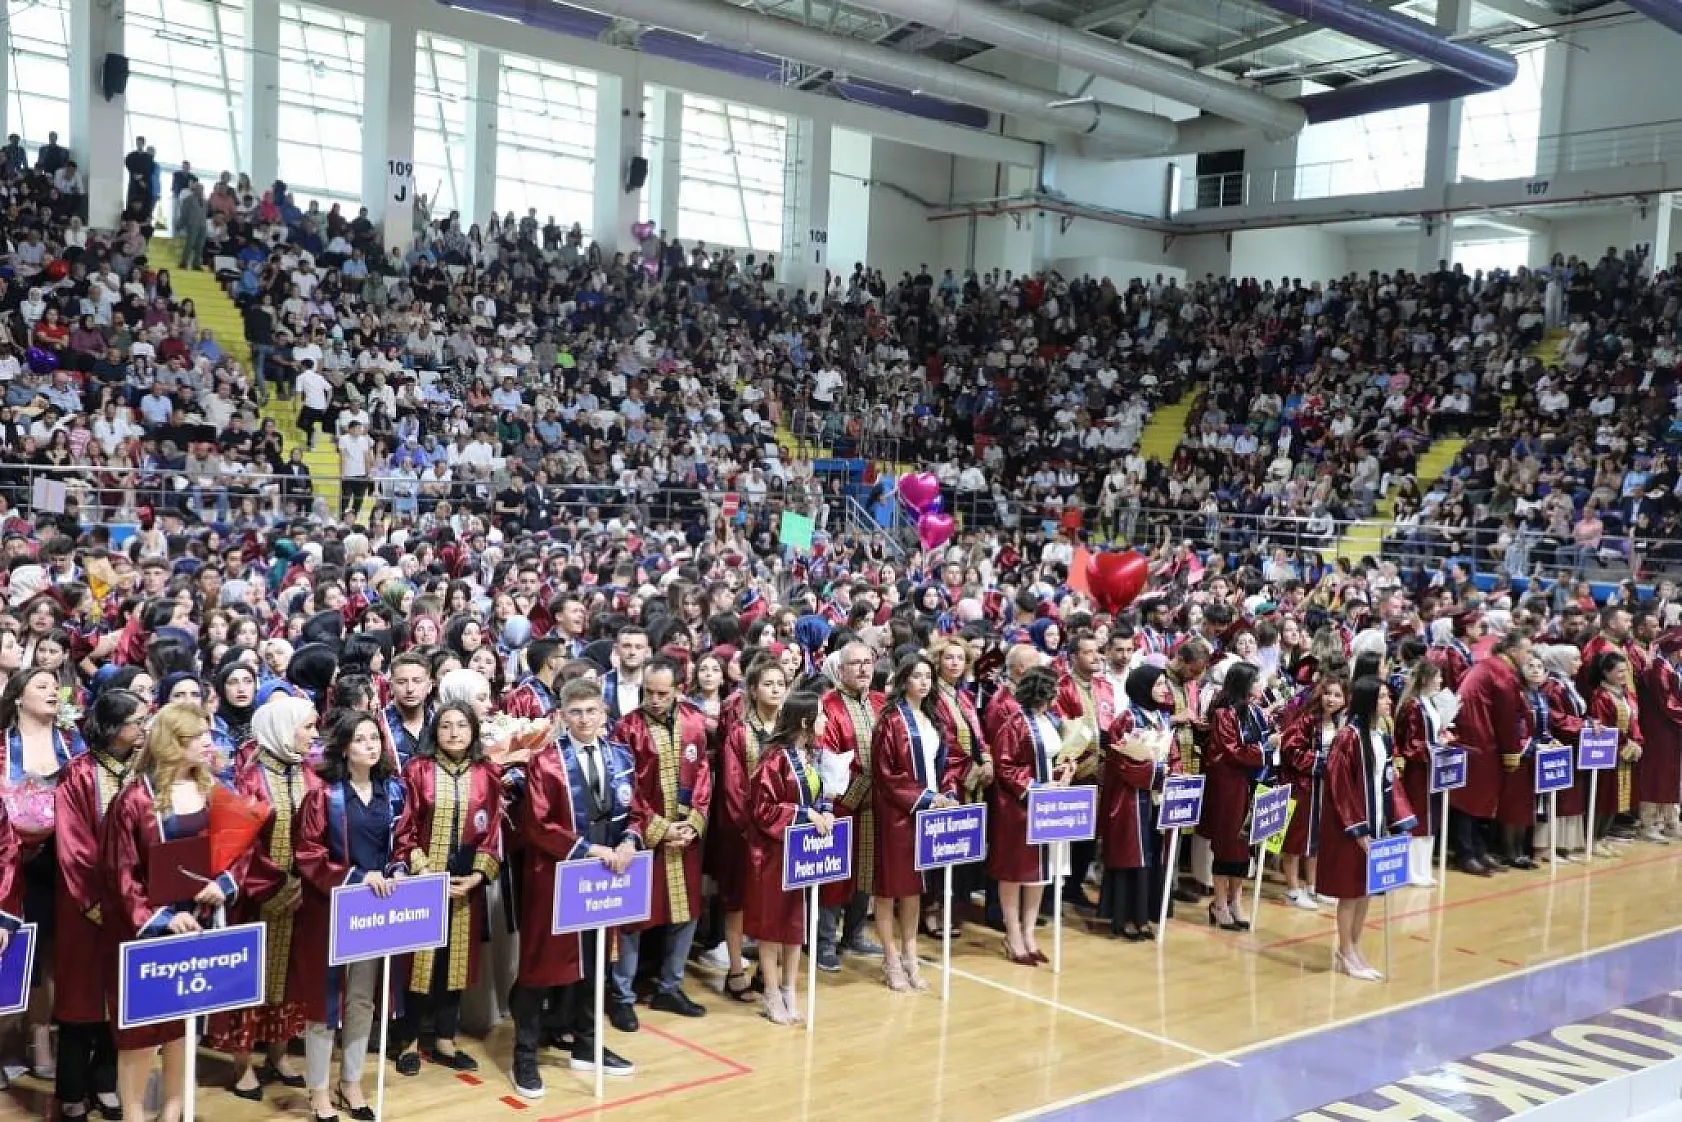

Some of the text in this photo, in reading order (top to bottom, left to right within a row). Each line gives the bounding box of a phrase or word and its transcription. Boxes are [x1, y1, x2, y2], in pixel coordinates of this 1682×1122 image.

[388, 160, 413, 178] 109
[394, 185, 406, 201] J
[1526, 181, 1549, 195] 107
[578, 876, 592, 894] İlk
[595, 879, 608, 891] ve
[585, 896, 623, 912] Yardım
[349, 907, 430, 931] Hasta Bakımı
[139, 946, 248, 979] Fizyoterapi
[176, 972, 213, 997] İ.Ö.
